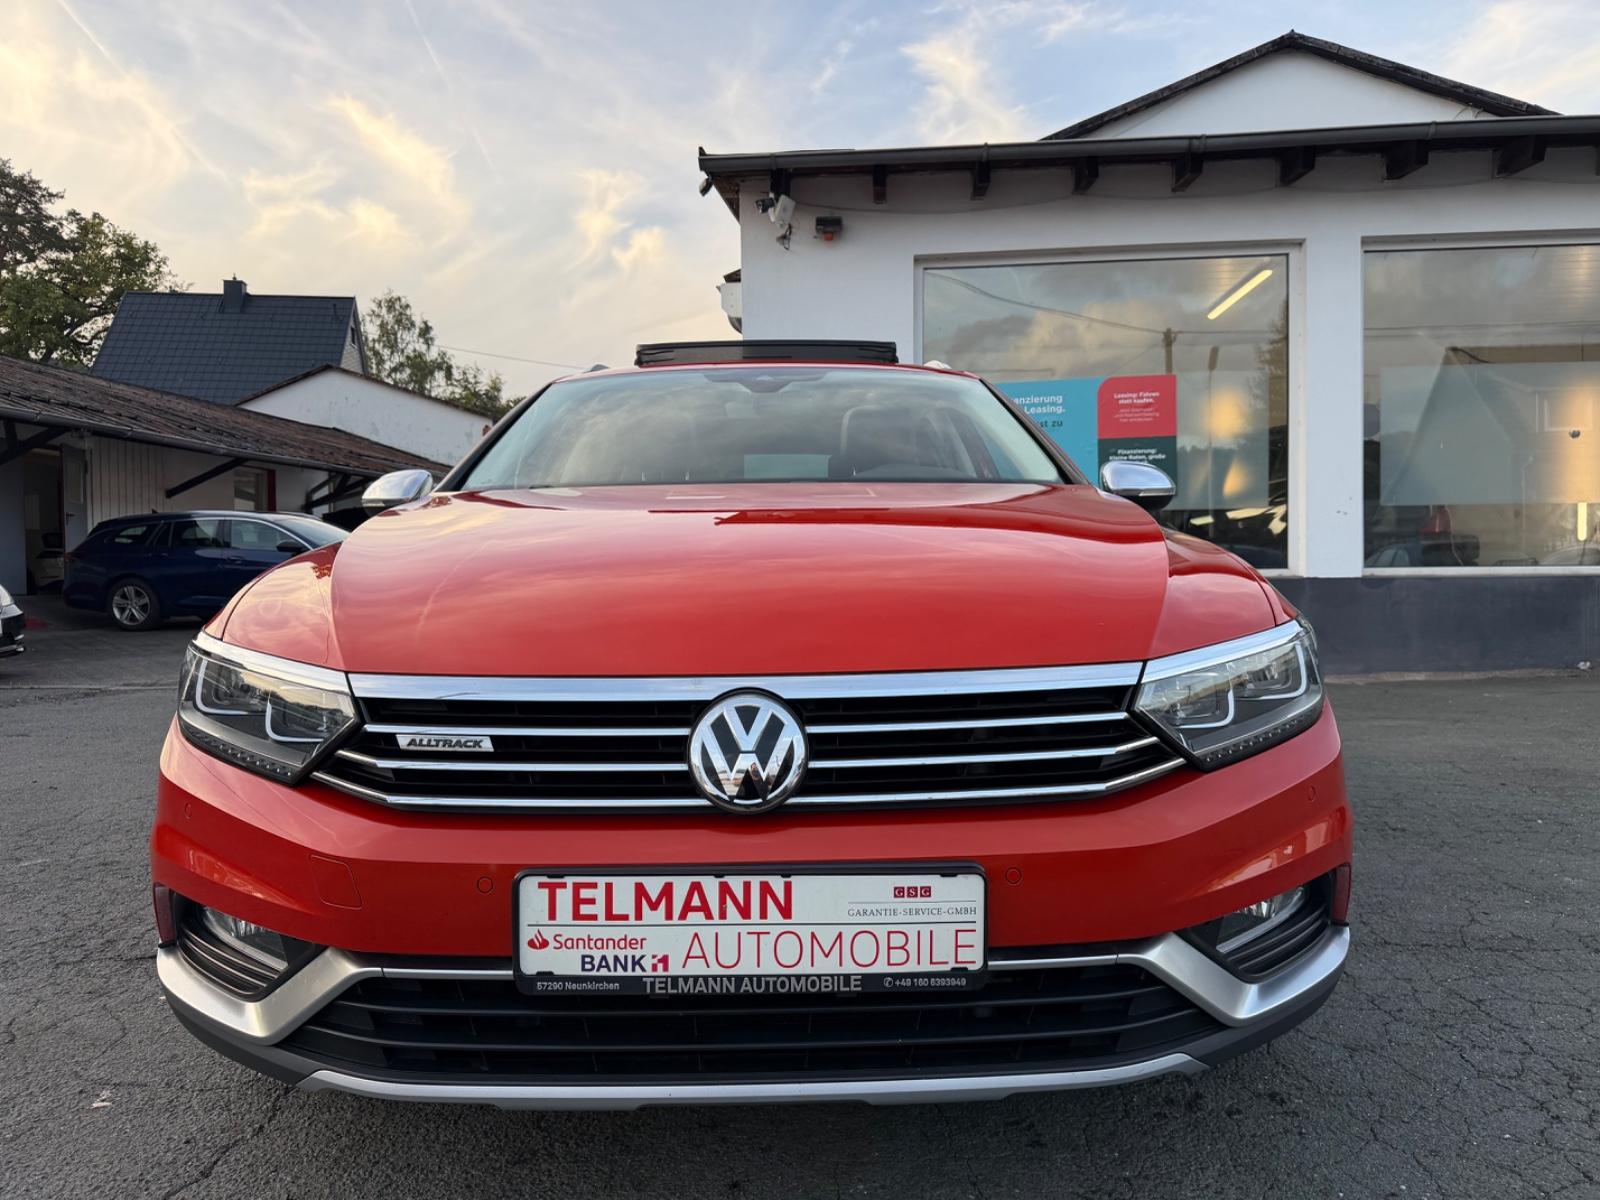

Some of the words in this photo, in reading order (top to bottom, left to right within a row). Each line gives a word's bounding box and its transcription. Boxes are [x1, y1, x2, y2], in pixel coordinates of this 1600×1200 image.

[1012, 395, 1063, 404] anzierung
[1024, 405, 1066, 414] Leasing.
[407, 738, 483, 749] ALLTRACK
[538, 880, 793, 922] TELMANN
[552, 933, 648, 950] Santander
[682, 929, 977, 968] AUTOMOBILE
[580, 954, 647, 973] BANK
[536, 982, 563, 991] 57290
[565, 982, 620, 991] Neunkirchen
[643, 977, 735, 994] TELMANN
[740, 975, 862, 993] AUTOMOBILE
[894, 978, 912, 987] +49
